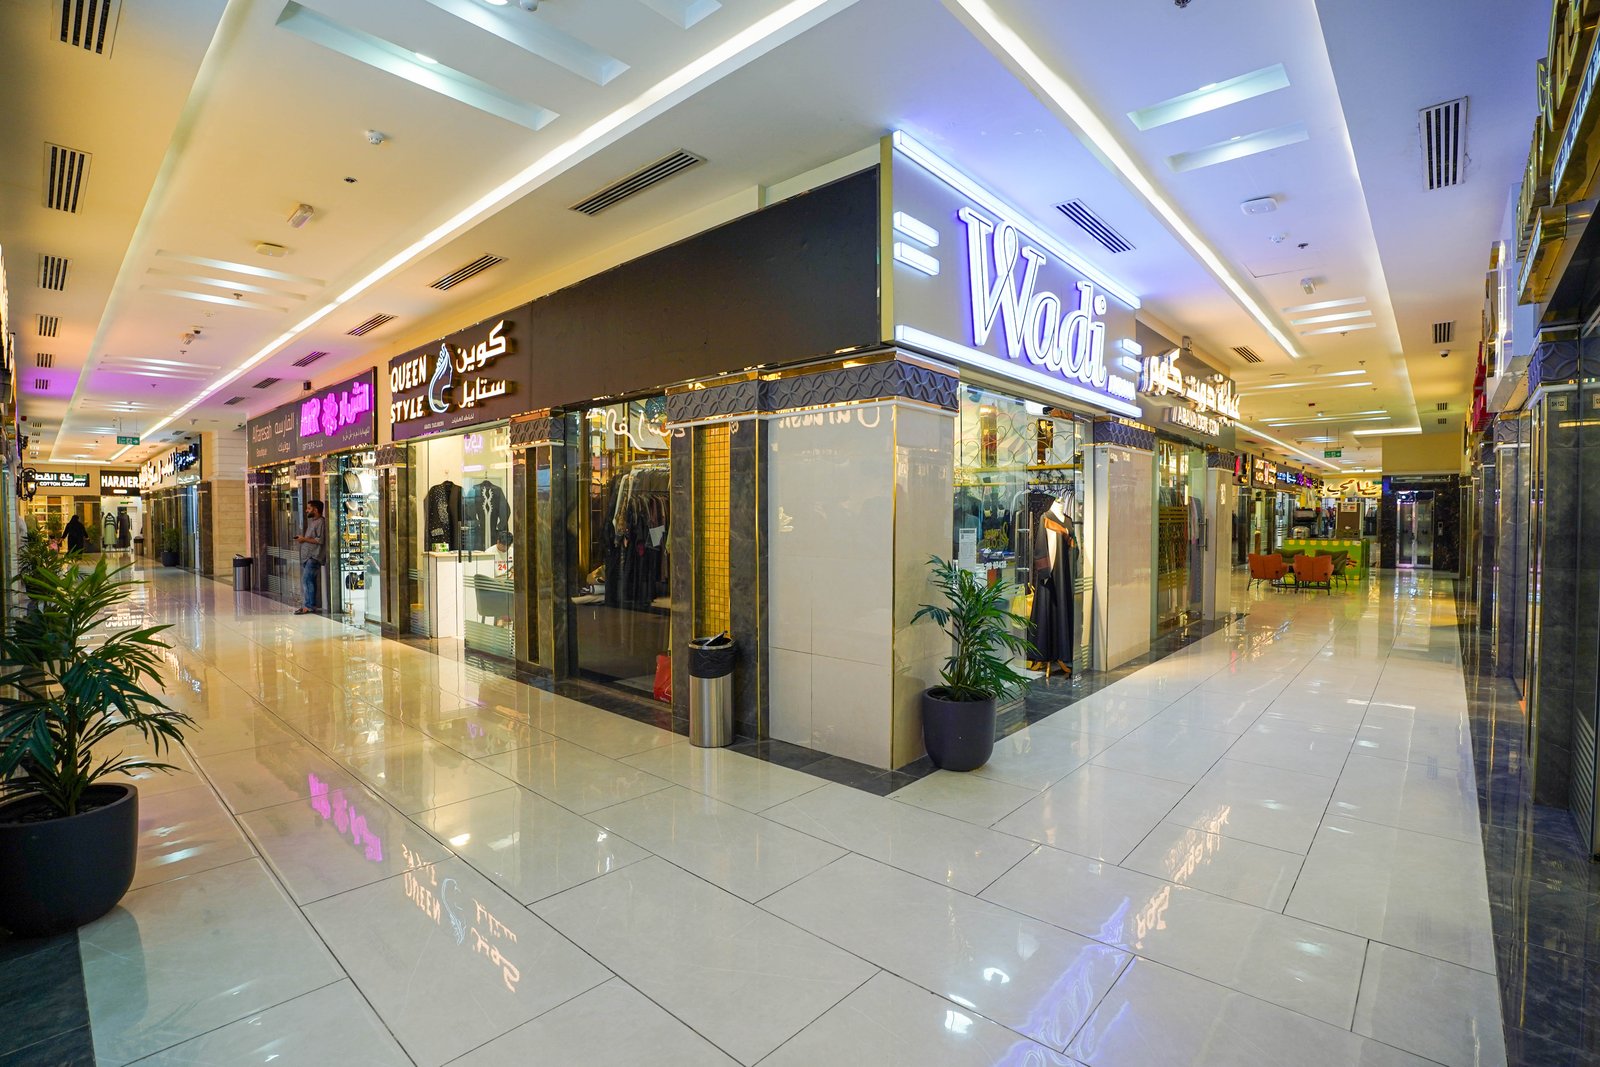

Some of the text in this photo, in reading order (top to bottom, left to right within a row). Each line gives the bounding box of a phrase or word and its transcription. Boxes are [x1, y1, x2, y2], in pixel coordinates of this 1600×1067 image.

[958, 206, 1107, 388] Wadi
[456, 320, 507, 373] كوين
[391, 354, 427, 393] QUEEN
[390, 395, 424, 424] STYLE
[458, 376, 506, 409] ستايل
[101, 475, 139, 488] HARAIER
